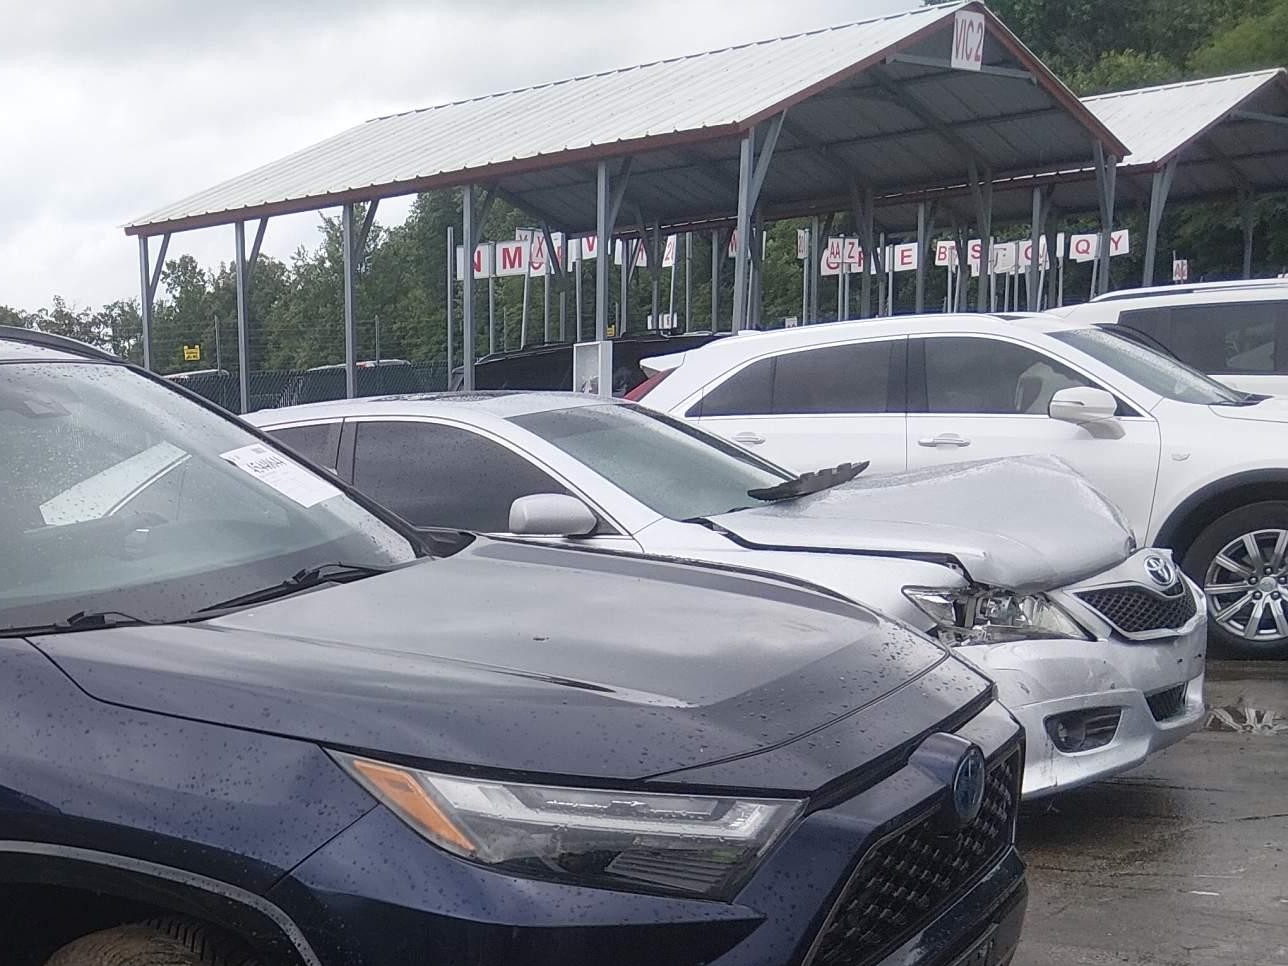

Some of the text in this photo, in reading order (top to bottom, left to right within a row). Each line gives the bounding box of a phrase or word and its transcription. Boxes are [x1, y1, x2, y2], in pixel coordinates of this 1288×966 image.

[848, 242, 856, 259] Z
[1075, 239, 1091, 255] Q
[1111, 235, 1122, 251] Y
[502, 246, 522, 269] M
[900, 248, 913, 266] E
